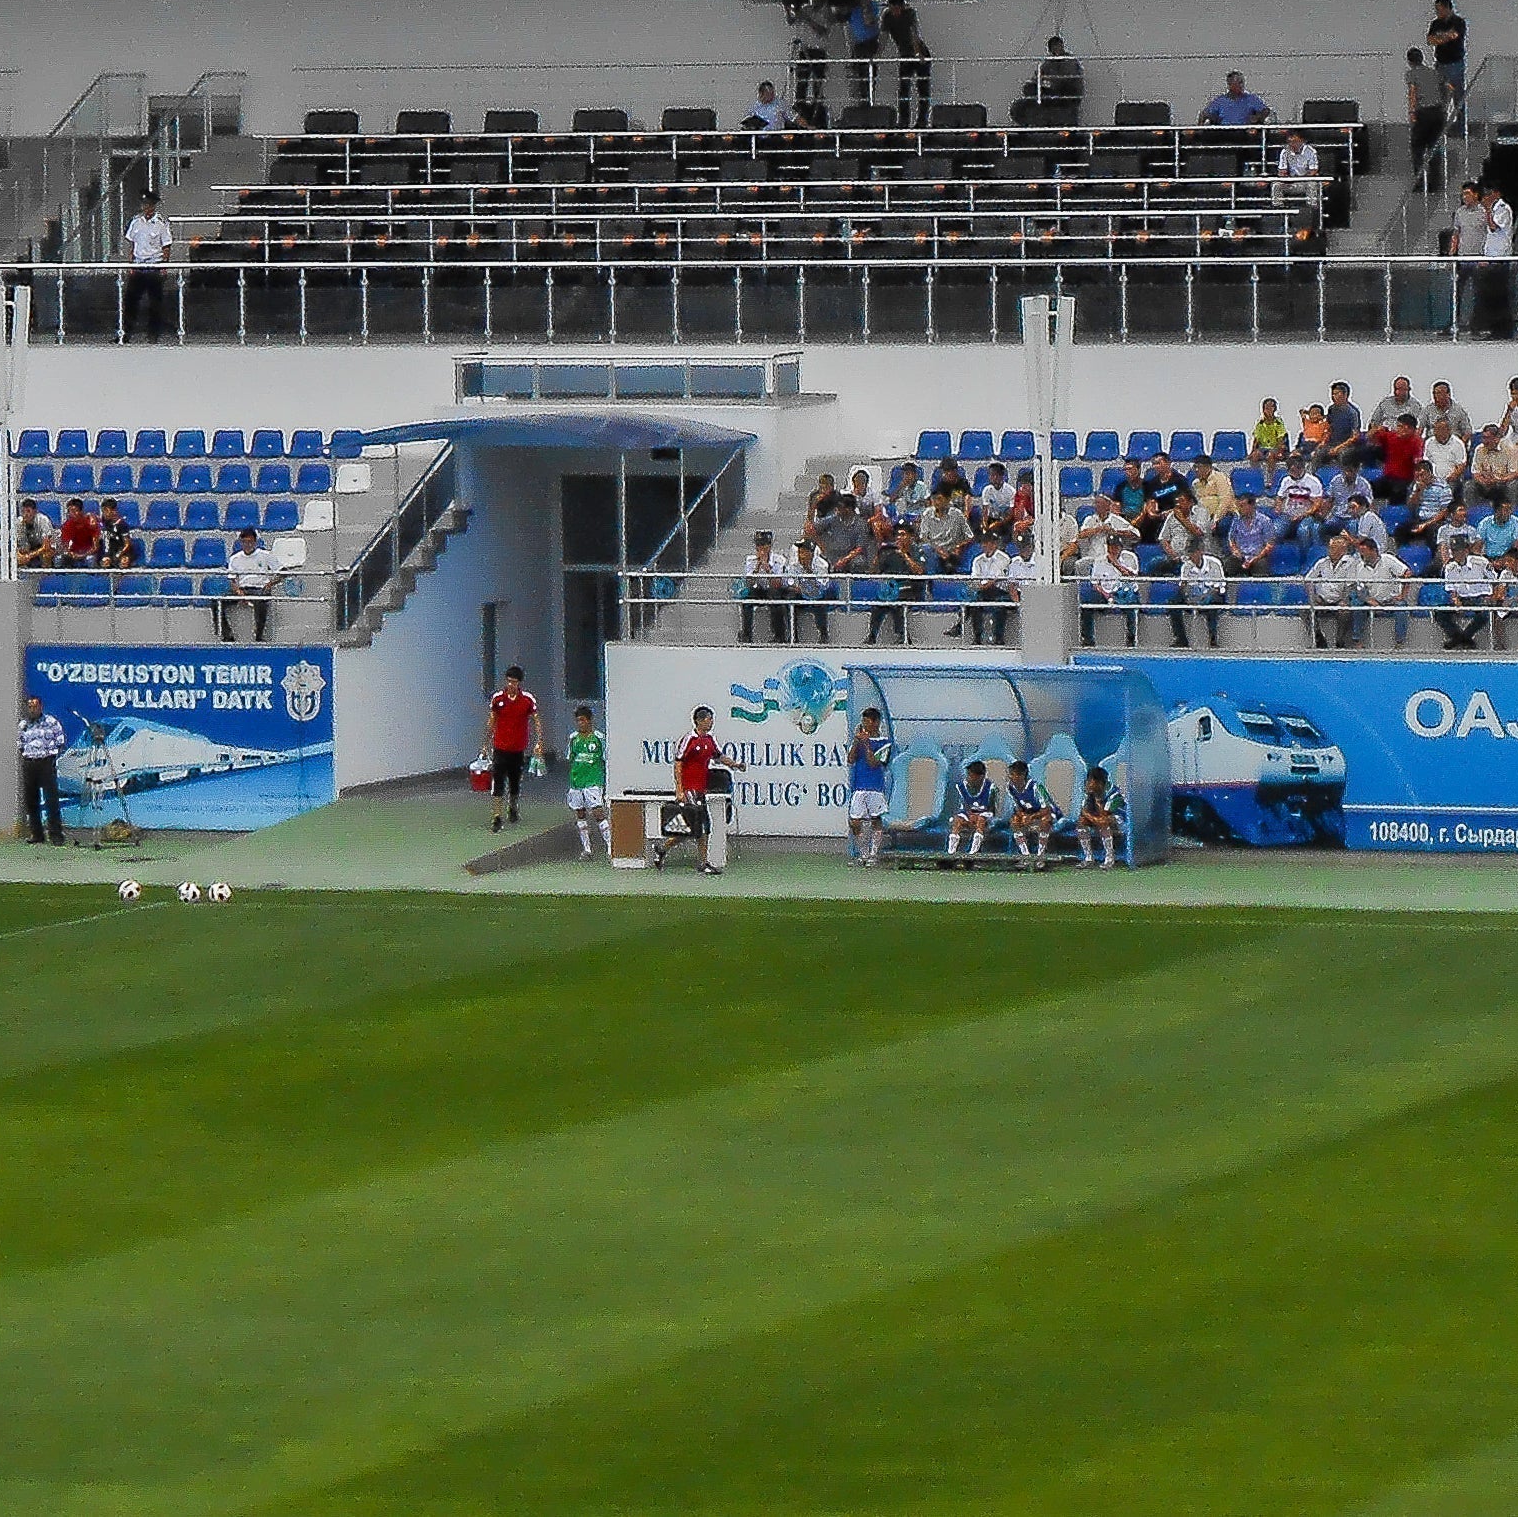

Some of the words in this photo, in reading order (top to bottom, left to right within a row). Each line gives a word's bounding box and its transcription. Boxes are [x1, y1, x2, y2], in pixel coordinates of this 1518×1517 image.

[201, 664, 273, 685] TEMIR
[212, 689, 273, 710] DATK
[1369, 821, 1434, 845] 108400,
[1439, 827, 1450, 843] г.
